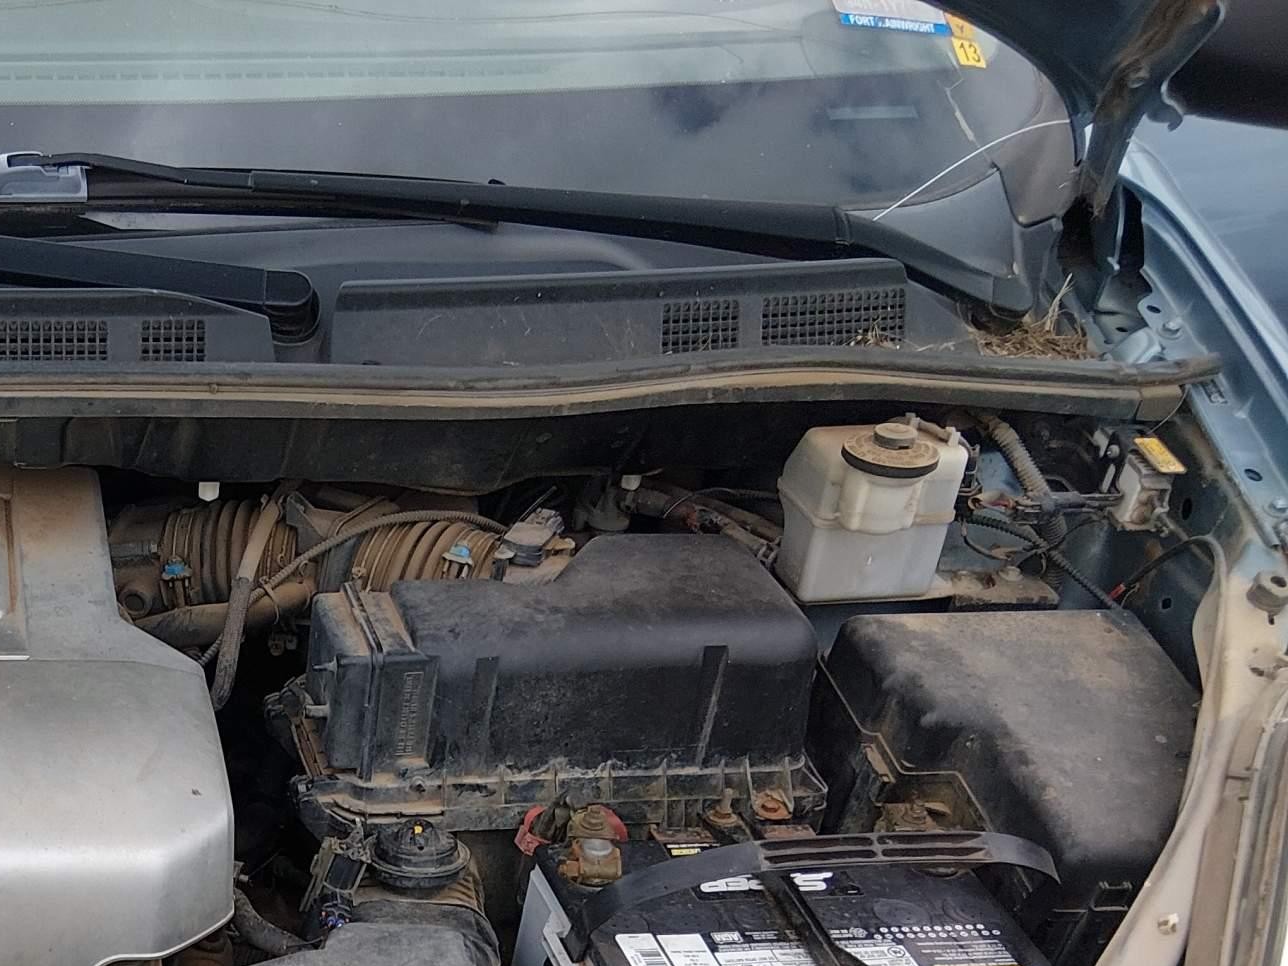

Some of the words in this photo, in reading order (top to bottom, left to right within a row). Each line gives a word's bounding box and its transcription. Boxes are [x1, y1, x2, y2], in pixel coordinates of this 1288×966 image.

[848, 14, 874, 27] FORT
[875, 16, 935, 33] AINWRIGHT
[959, 42, 981, 63] 13
